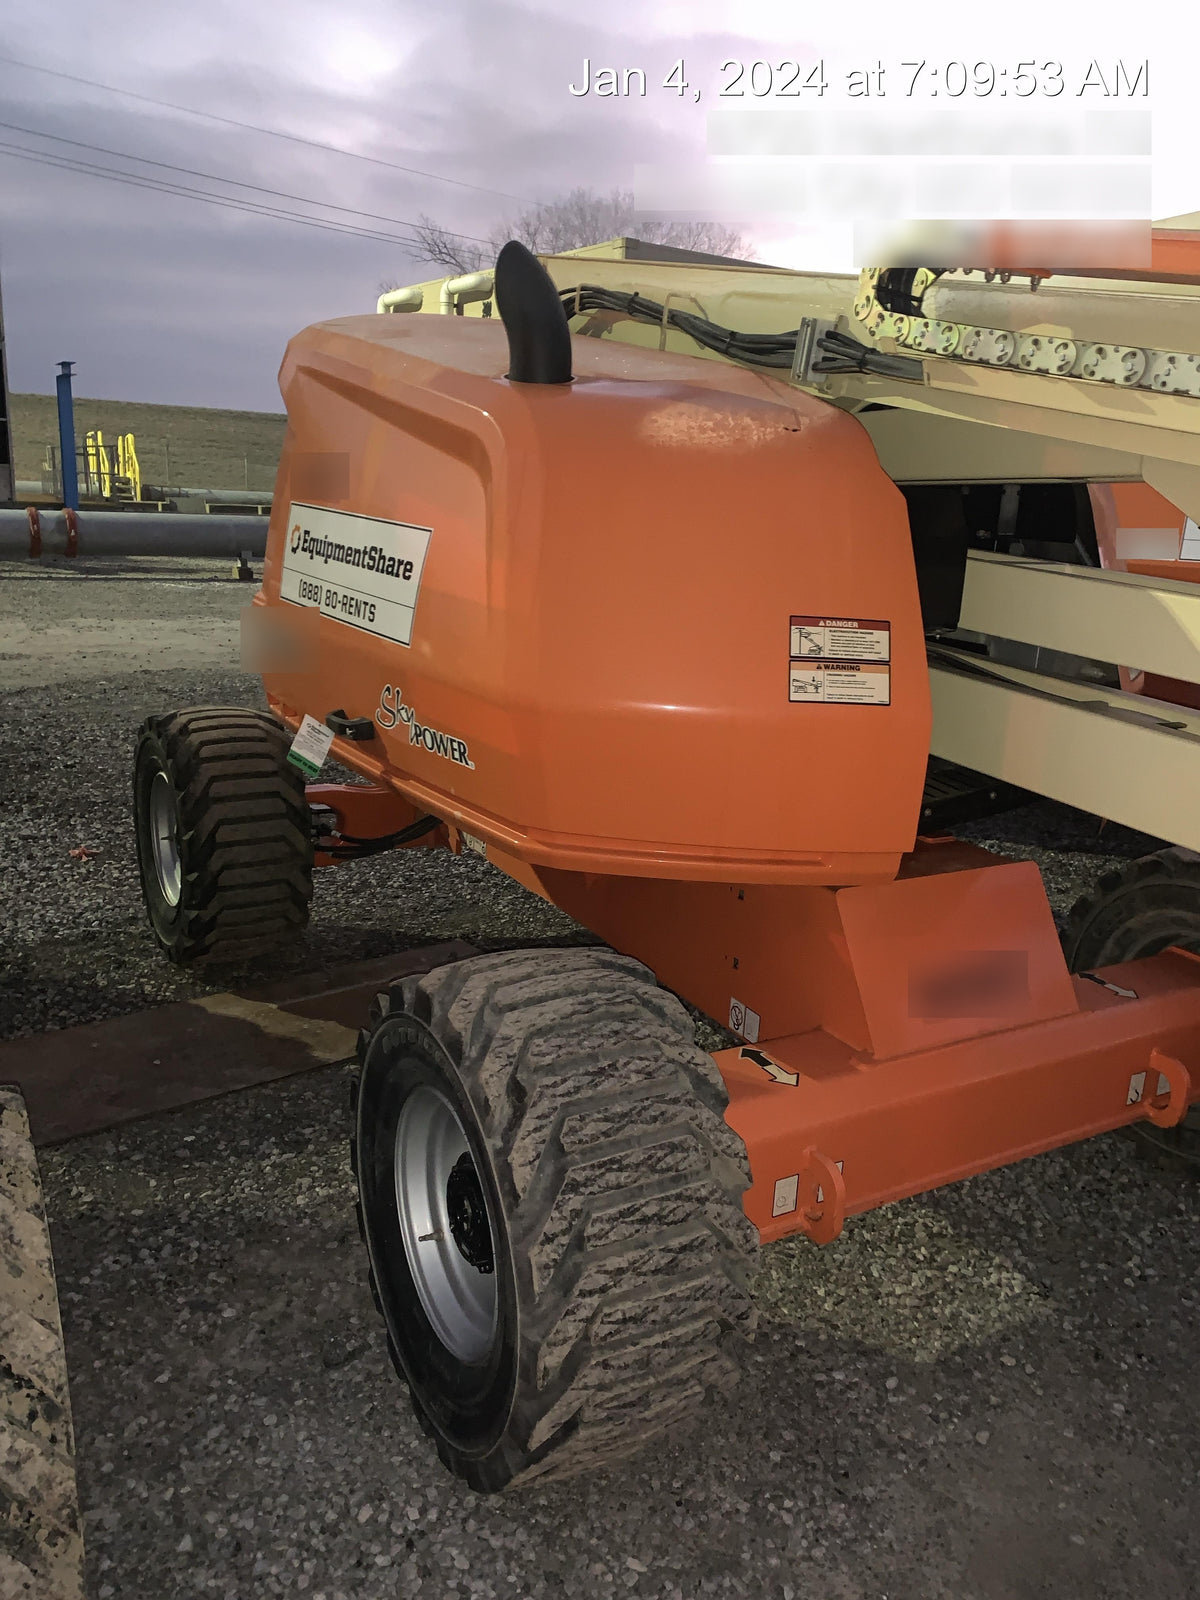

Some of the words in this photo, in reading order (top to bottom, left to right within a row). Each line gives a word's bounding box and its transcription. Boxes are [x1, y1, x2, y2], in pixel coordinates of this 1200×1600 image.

[301, 529, 414, 581] EquipmentShare
[299, 578, 323, 605] (888)
[324, 589, 377, 623] 80-RENTS
[826, 620, 859, 628] DANGER
[375, 684, 415, 745] Sky
[411, 722, 471, 767] POWER
